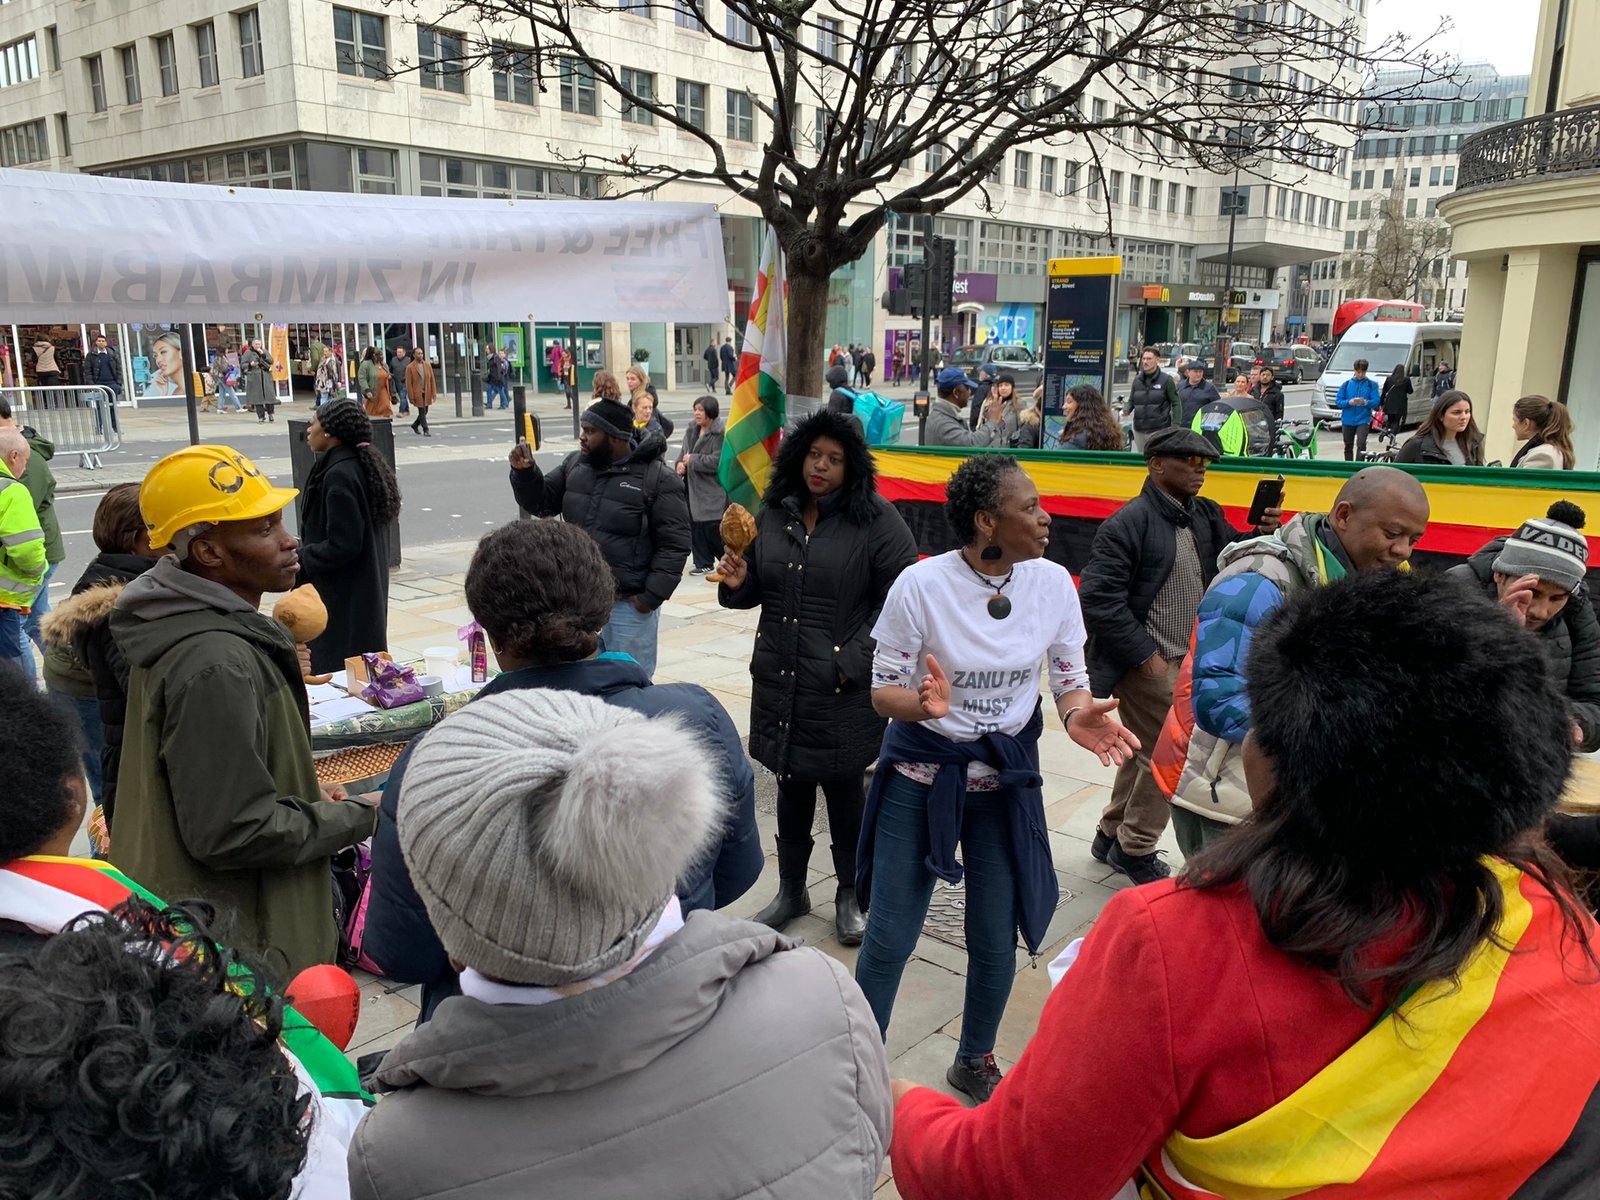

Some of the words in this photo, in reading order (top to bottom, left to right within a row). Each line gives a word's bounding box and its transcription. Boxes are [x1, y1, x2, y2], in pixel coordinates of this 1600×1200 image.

[952, 670, 1005, 689] ZANU
[1008, 668, 1032, 688] PF
[962, 696, 1014, 717] MUST
